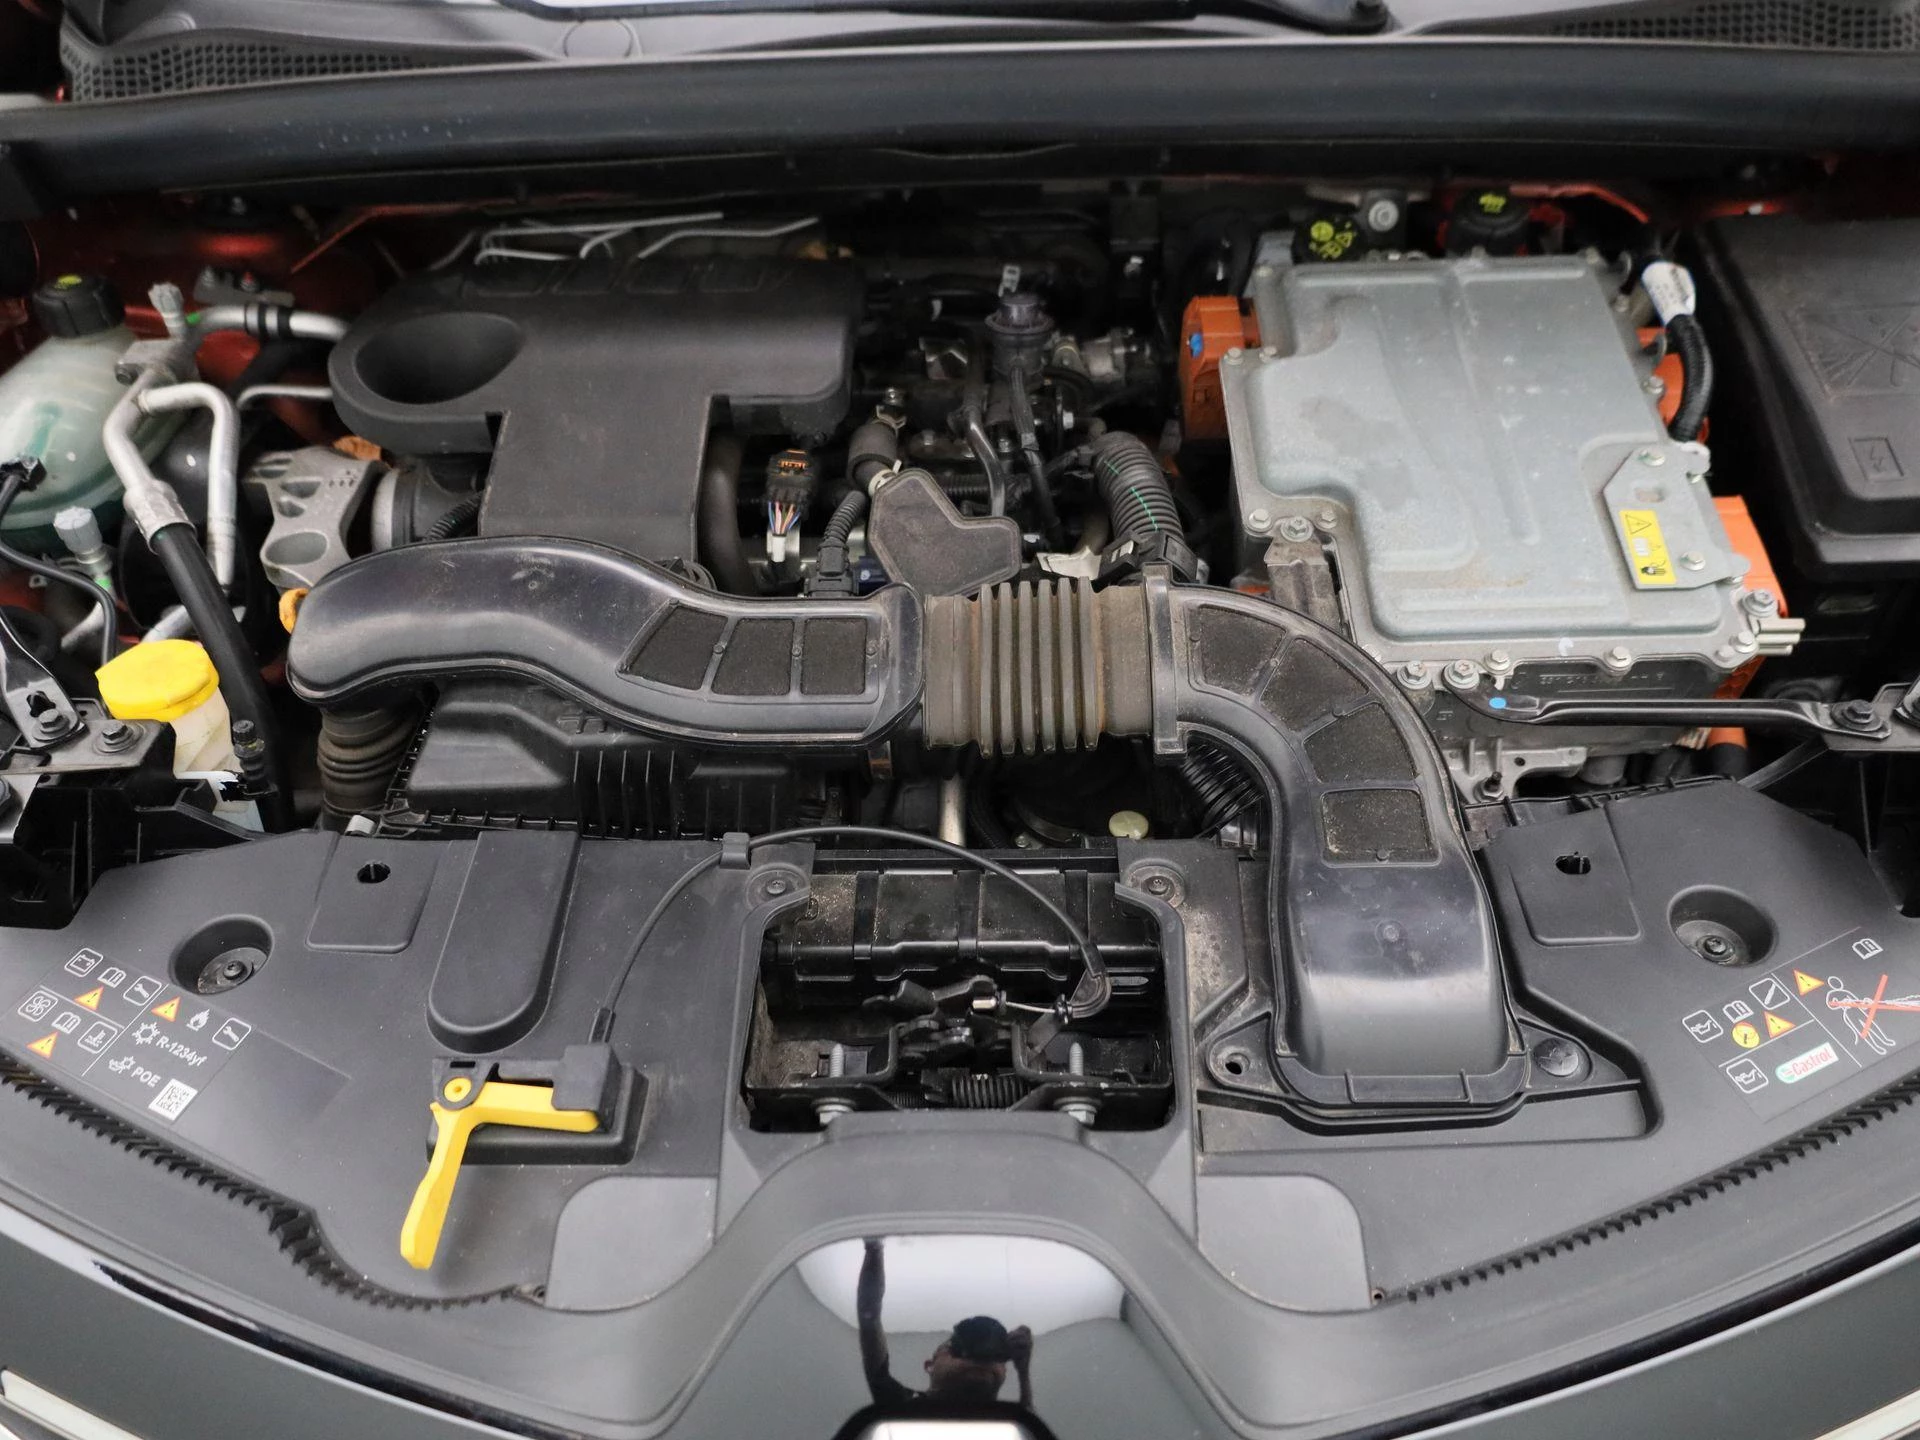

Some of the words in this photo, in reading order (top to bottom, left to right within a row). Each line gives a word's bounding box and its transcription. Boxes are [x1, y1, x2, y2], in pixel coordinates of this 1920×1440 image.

[156, 1036, 207, 1067] R-1234yf
[1791, 1047, 1832, 1075] Castrol
[131, 1066, 161, 1087] POE
